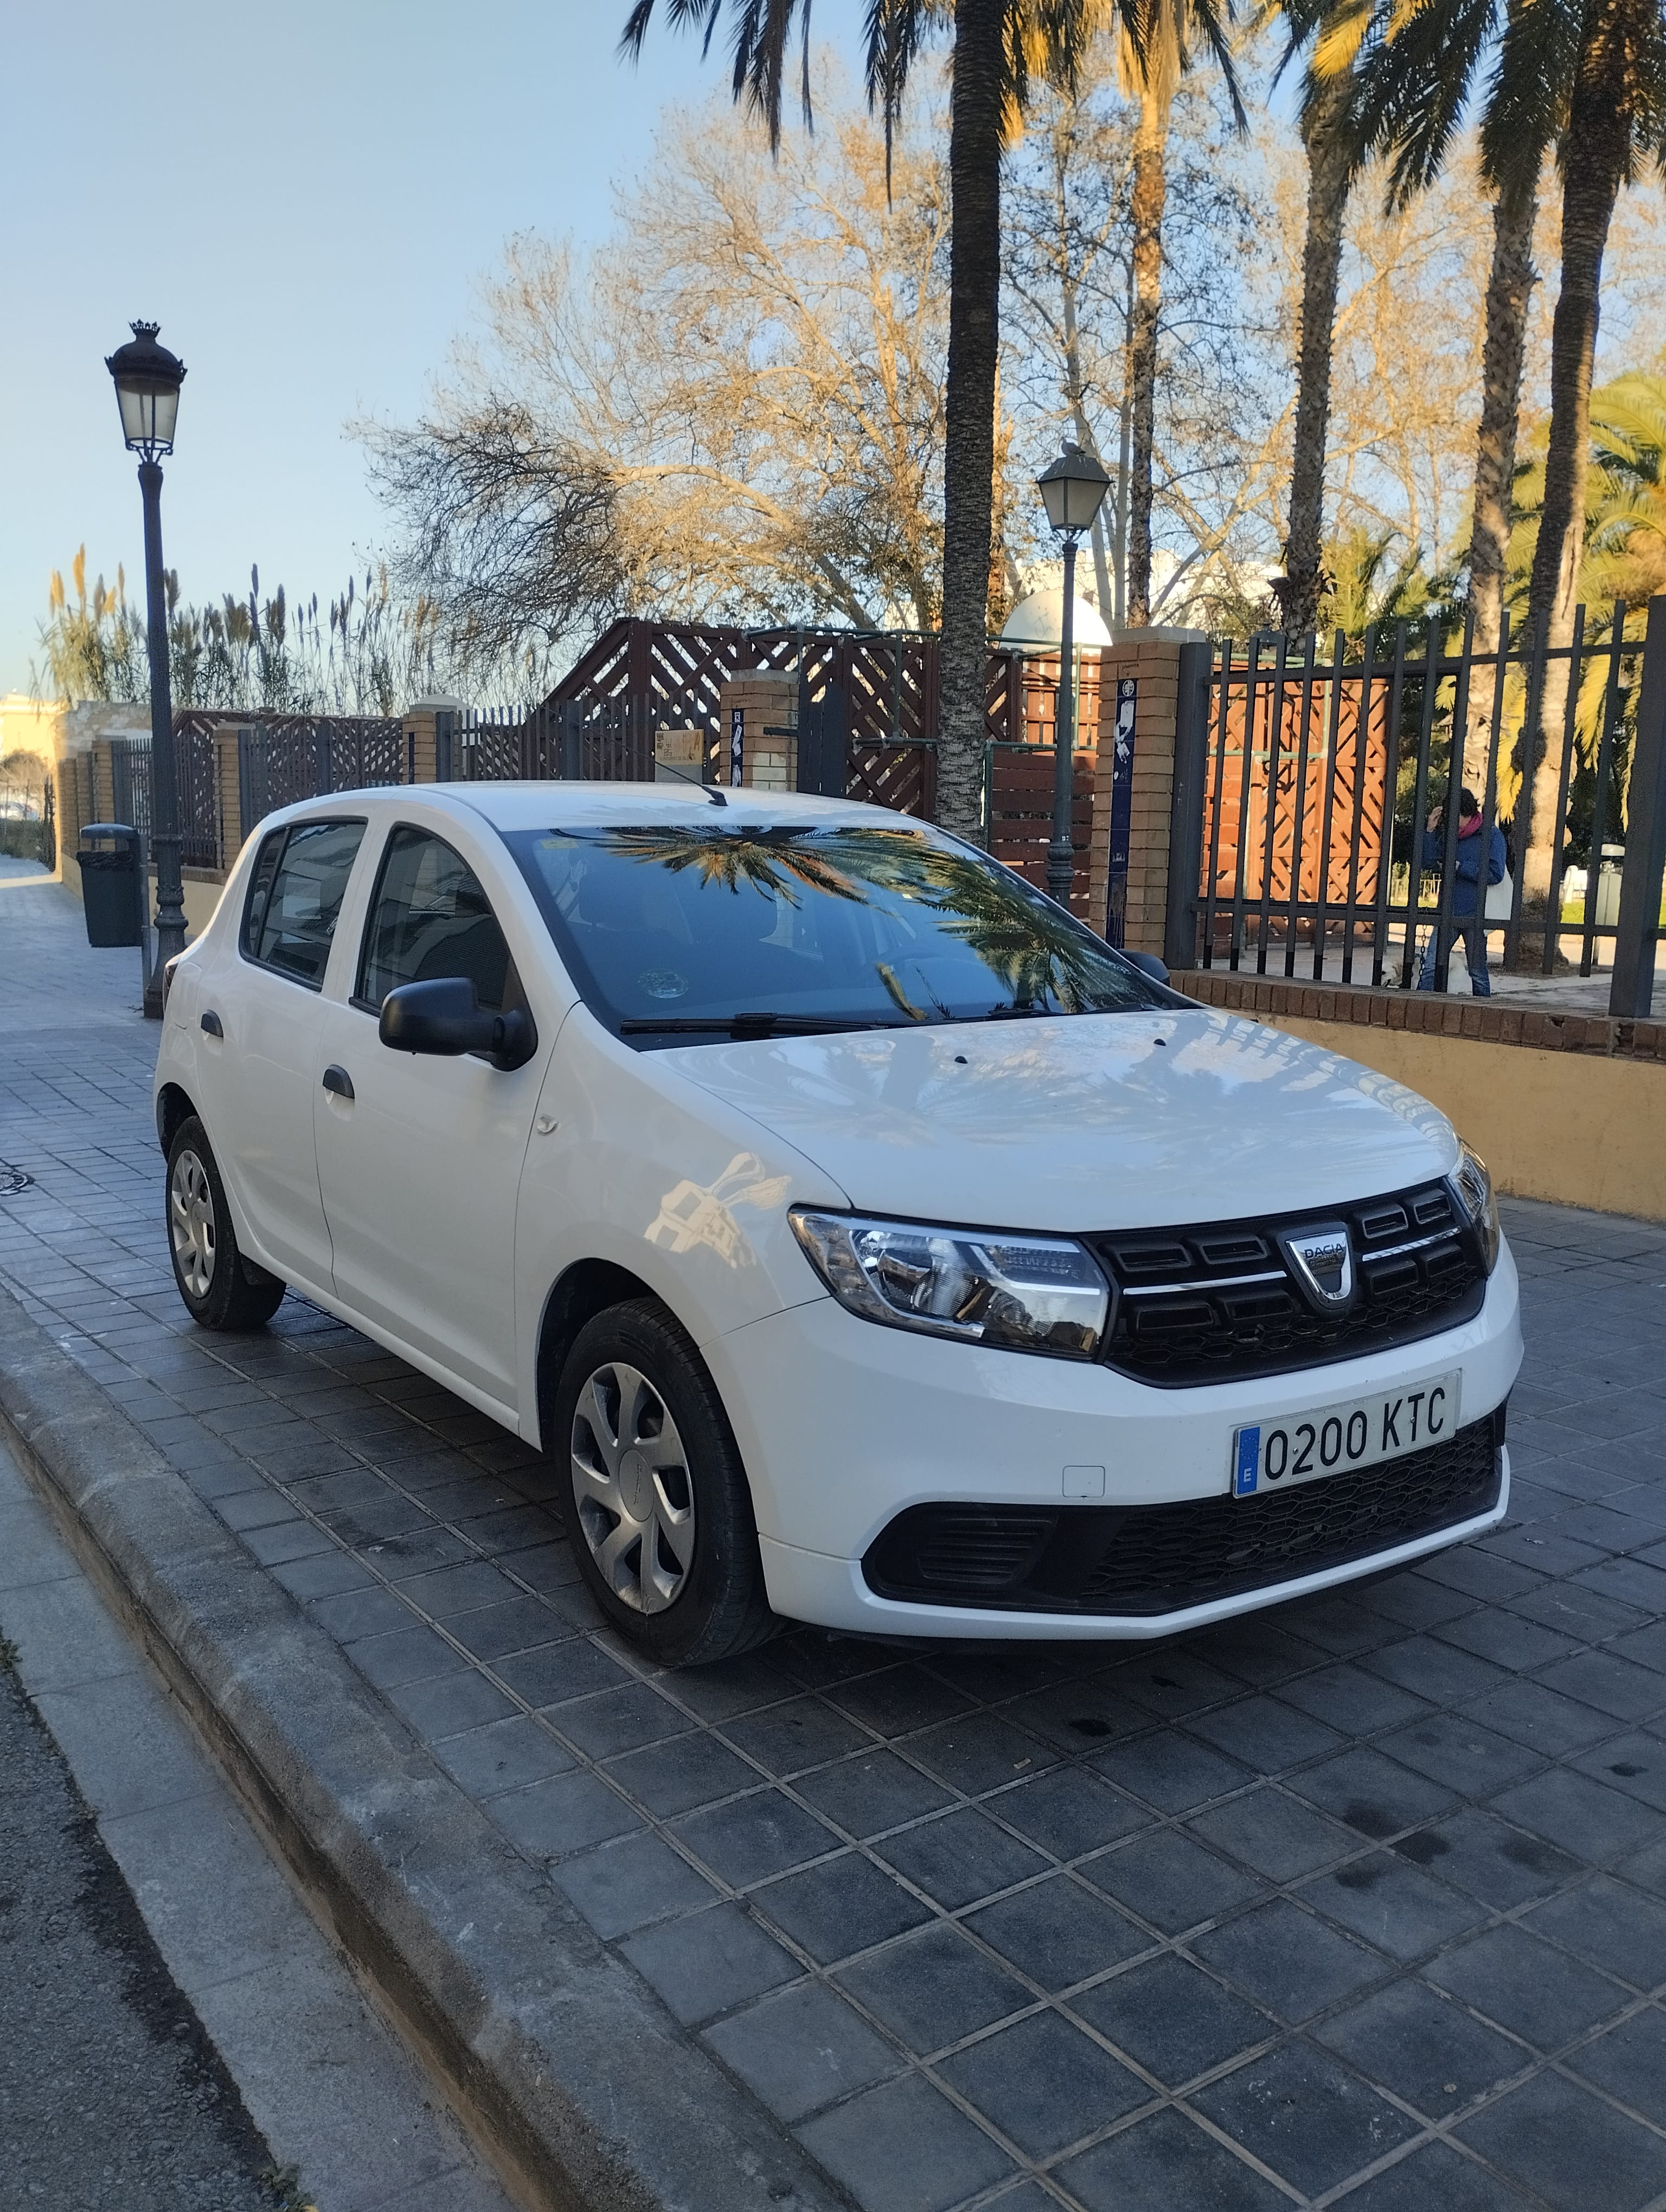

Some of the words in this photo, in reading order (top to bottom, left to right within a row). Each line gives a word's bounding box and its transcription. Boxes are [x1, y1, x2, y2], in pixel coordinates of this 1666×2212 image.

[1304, 1243, 1344, 1259] DACIA
[1265, 1411, 1367, 1480] 0200
[1382, 1387, 1445, 1451] KTC
[1244, 1467, 1252, 1483] E
